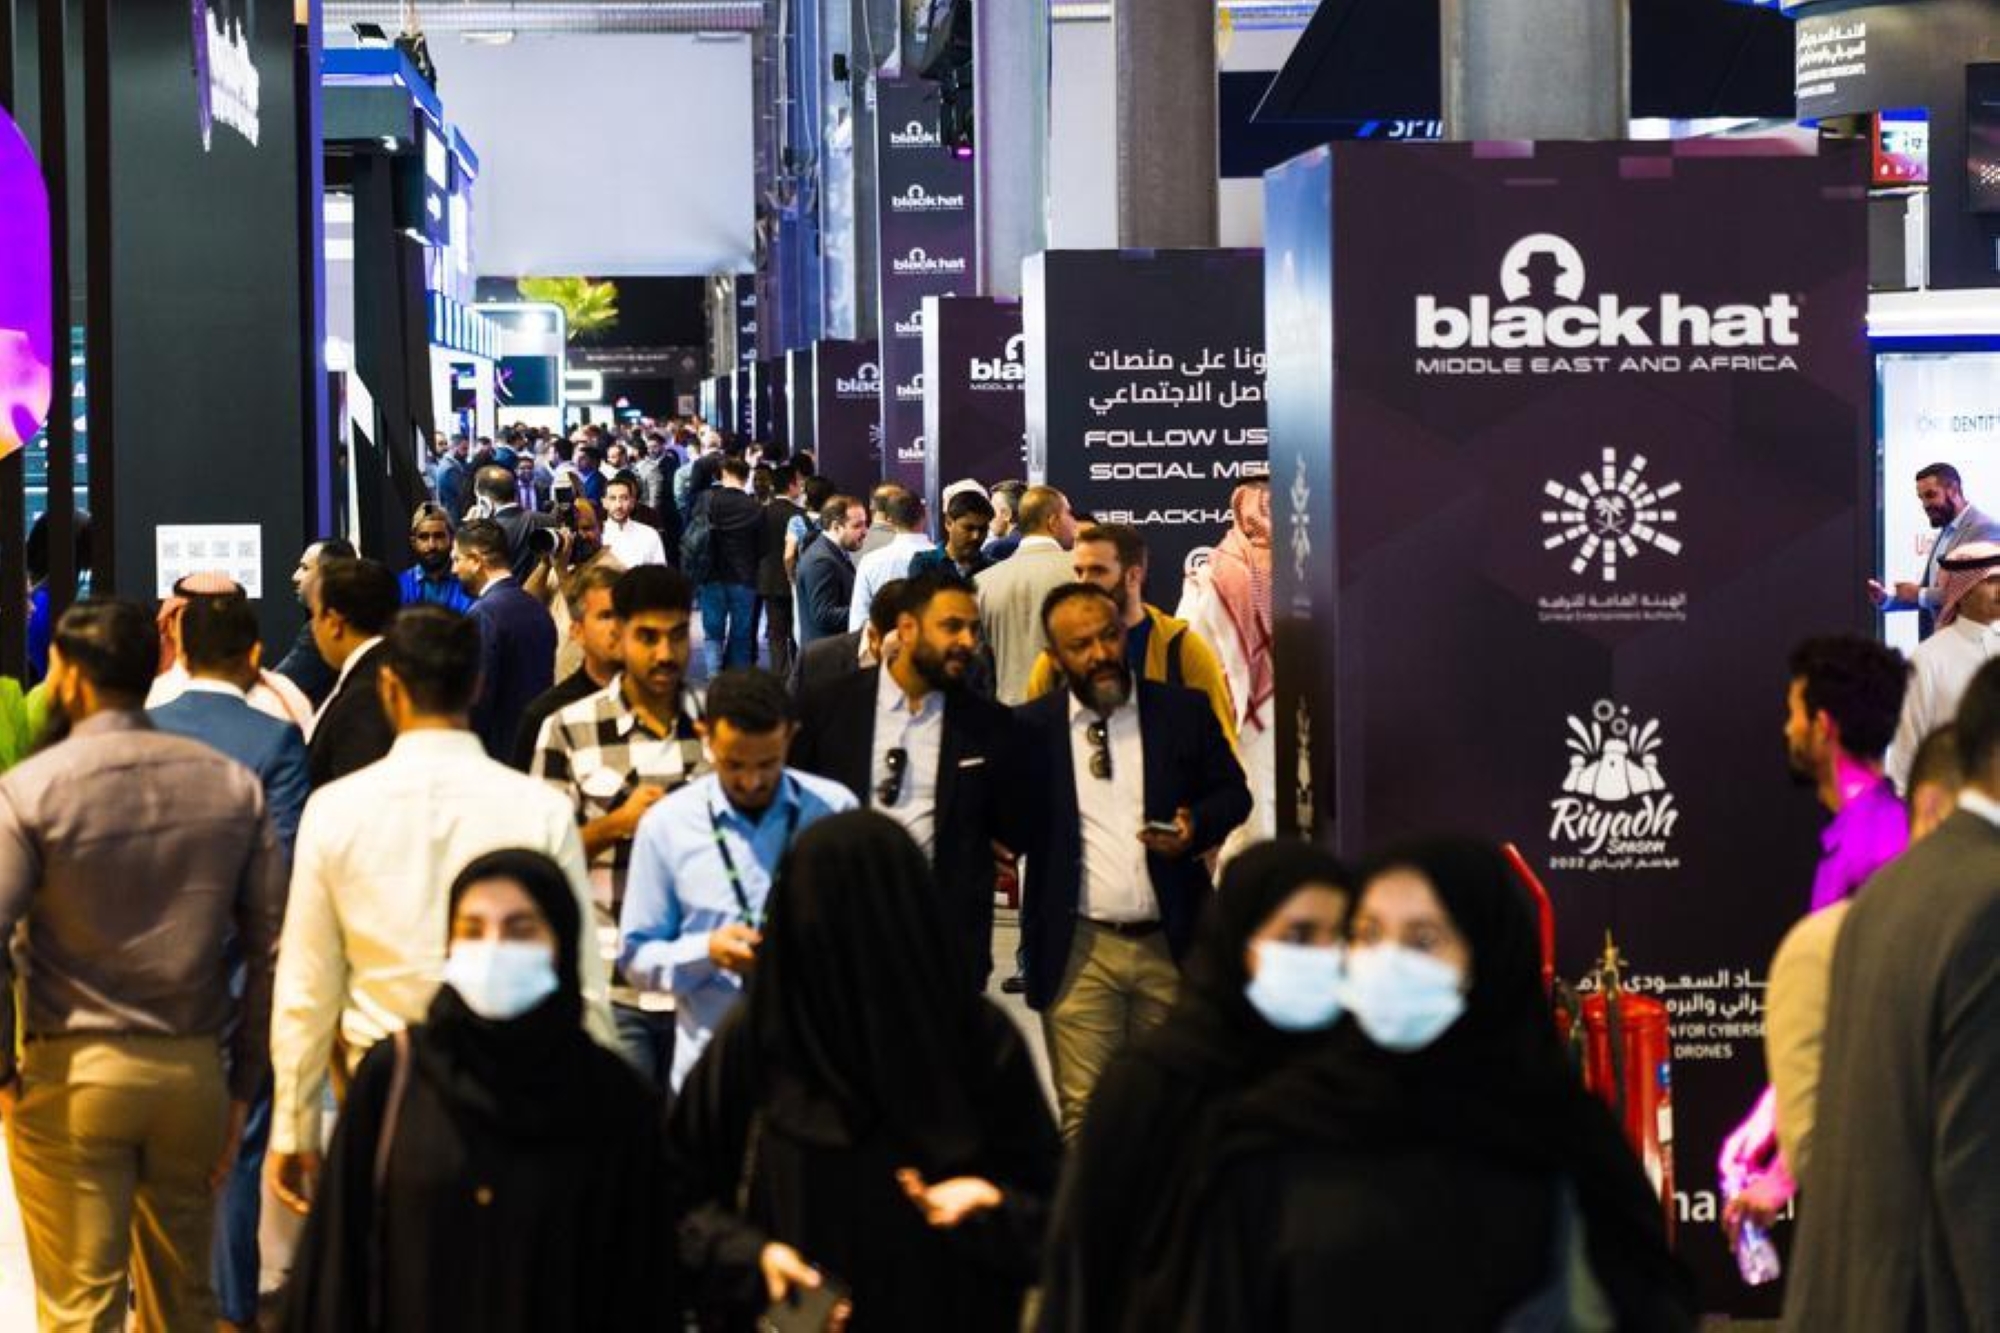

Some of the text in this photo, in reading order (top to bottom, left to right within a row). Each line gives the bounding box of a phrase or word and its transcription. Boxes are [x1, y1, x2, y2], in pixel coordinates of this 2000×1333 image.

[891, 131, 935, 144] black
[892, 195, 964, 208] black hat
[893, 257, 966, 271] black hat
[1415, 293, 1800, 349] black hat
[970, 357, 1024, 381] bla
[1088, 349, 1174, 371] منصات
[1180, 347, 1227, 376] على
[1415, 355, 1799, 375] MIDDLE EAST AND AFRICA
[836, 377, 881, 392] blac
[1088, 380, 1211, 416] الاجتماعي
[1084, 427, 1268, 448] FOLLOW US
[1089, 460, 1269, 480] SOCIAL ME
[1093, 508, 1237, 525] @BLACKHA
[1548, 792, 1679, 855] Riyadh
[1679, 1023, 1706, 1037] FOR
[1708, 1022, 1766, 1037] CYBERS
[1673, 1043, 1733, 1059] DRONES
